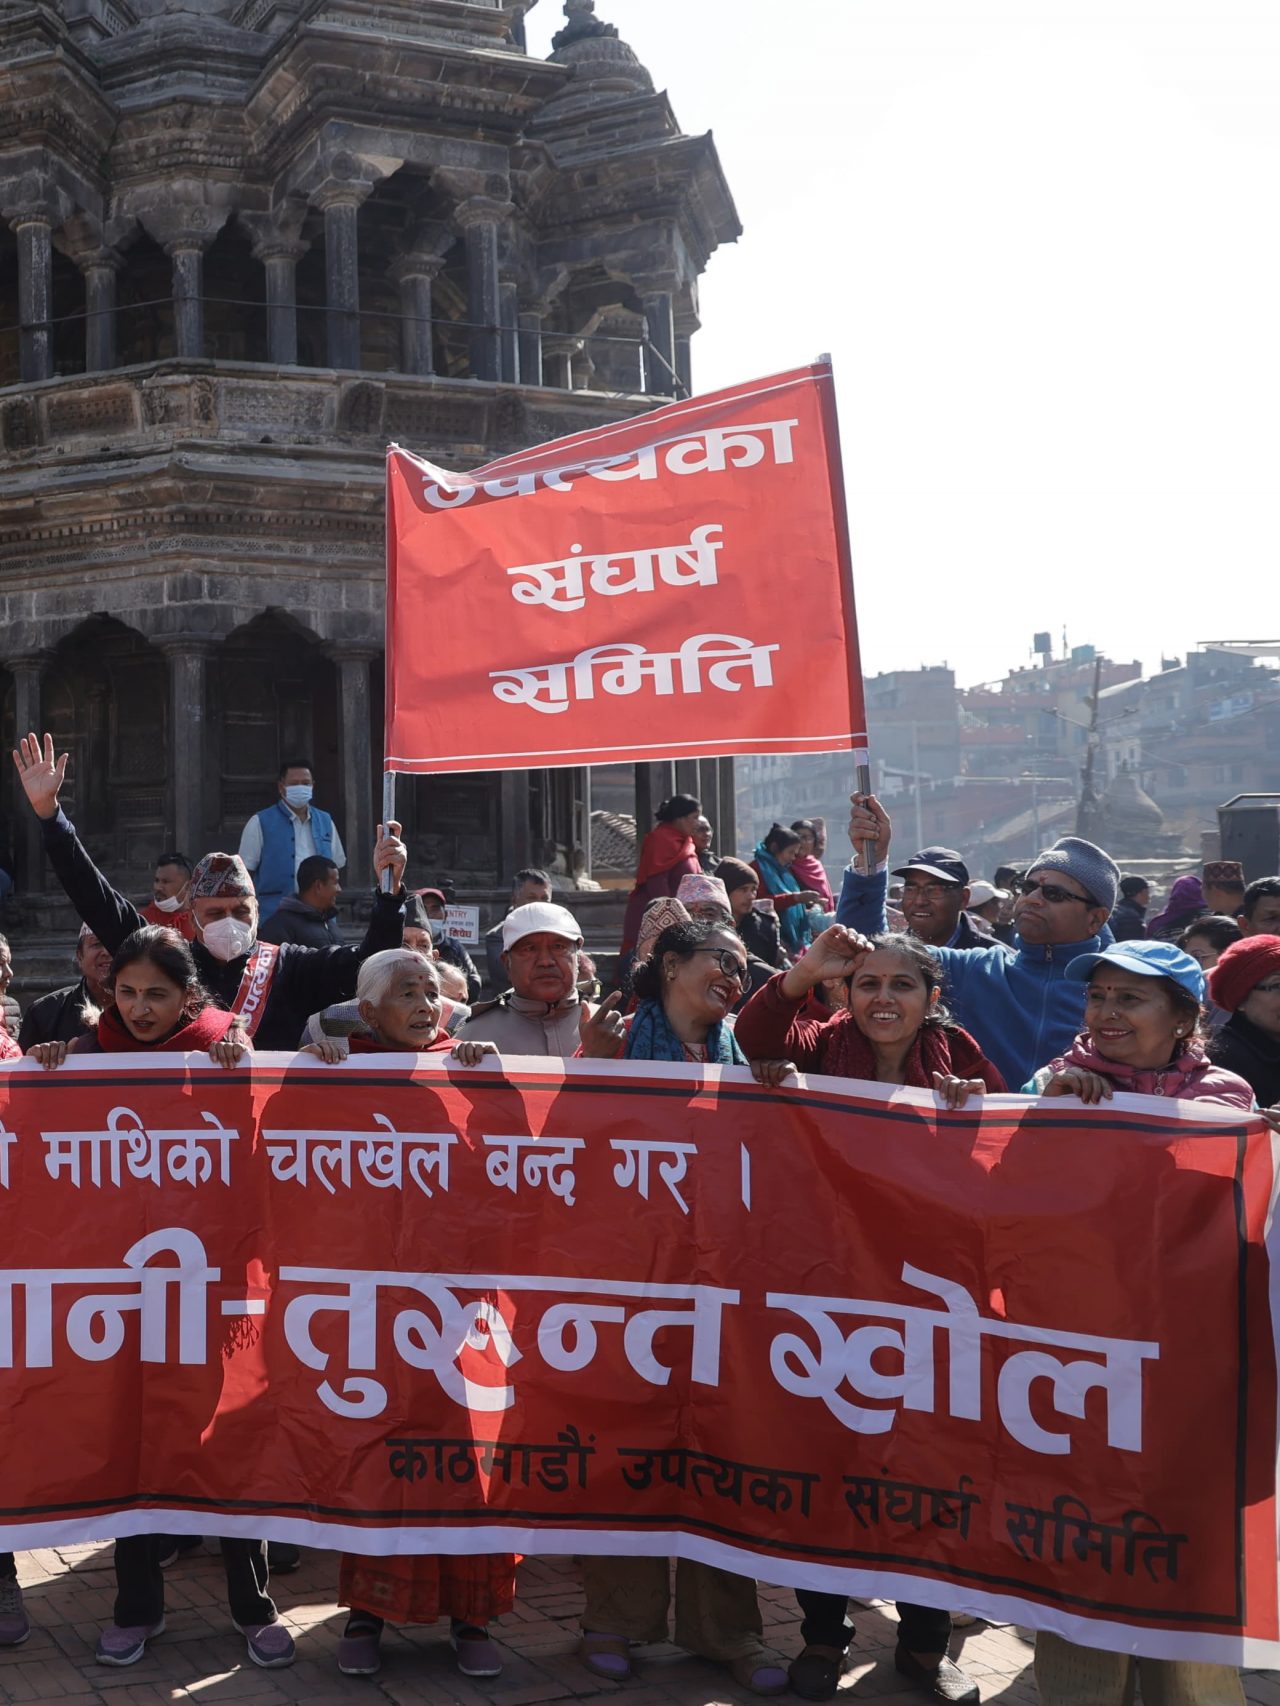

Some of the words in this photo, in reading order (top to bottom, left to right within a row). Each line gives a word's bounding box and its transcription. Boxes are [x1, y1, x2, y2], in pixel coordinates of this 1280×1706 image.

[507, 524, 723, 612] संघर्ष
[489, 633, 780, 714] समिति
[40, 1107, 239, 1188] माथिको
[262, 1113, 458, 1197] चलखेल
[482, 1135, 585, 1206] बन्द
[610, 1139, 698, 1214] गर
[766, 1262, 1159, 1454] खोल
[385, 1424, 596, 1493] काठमाडौं
[617, 1447, 819, 1519] उपत्यका
[842, 1466, 980, 1541] संघर्ष
[1006, 1494, 1188, 1583] समिति
